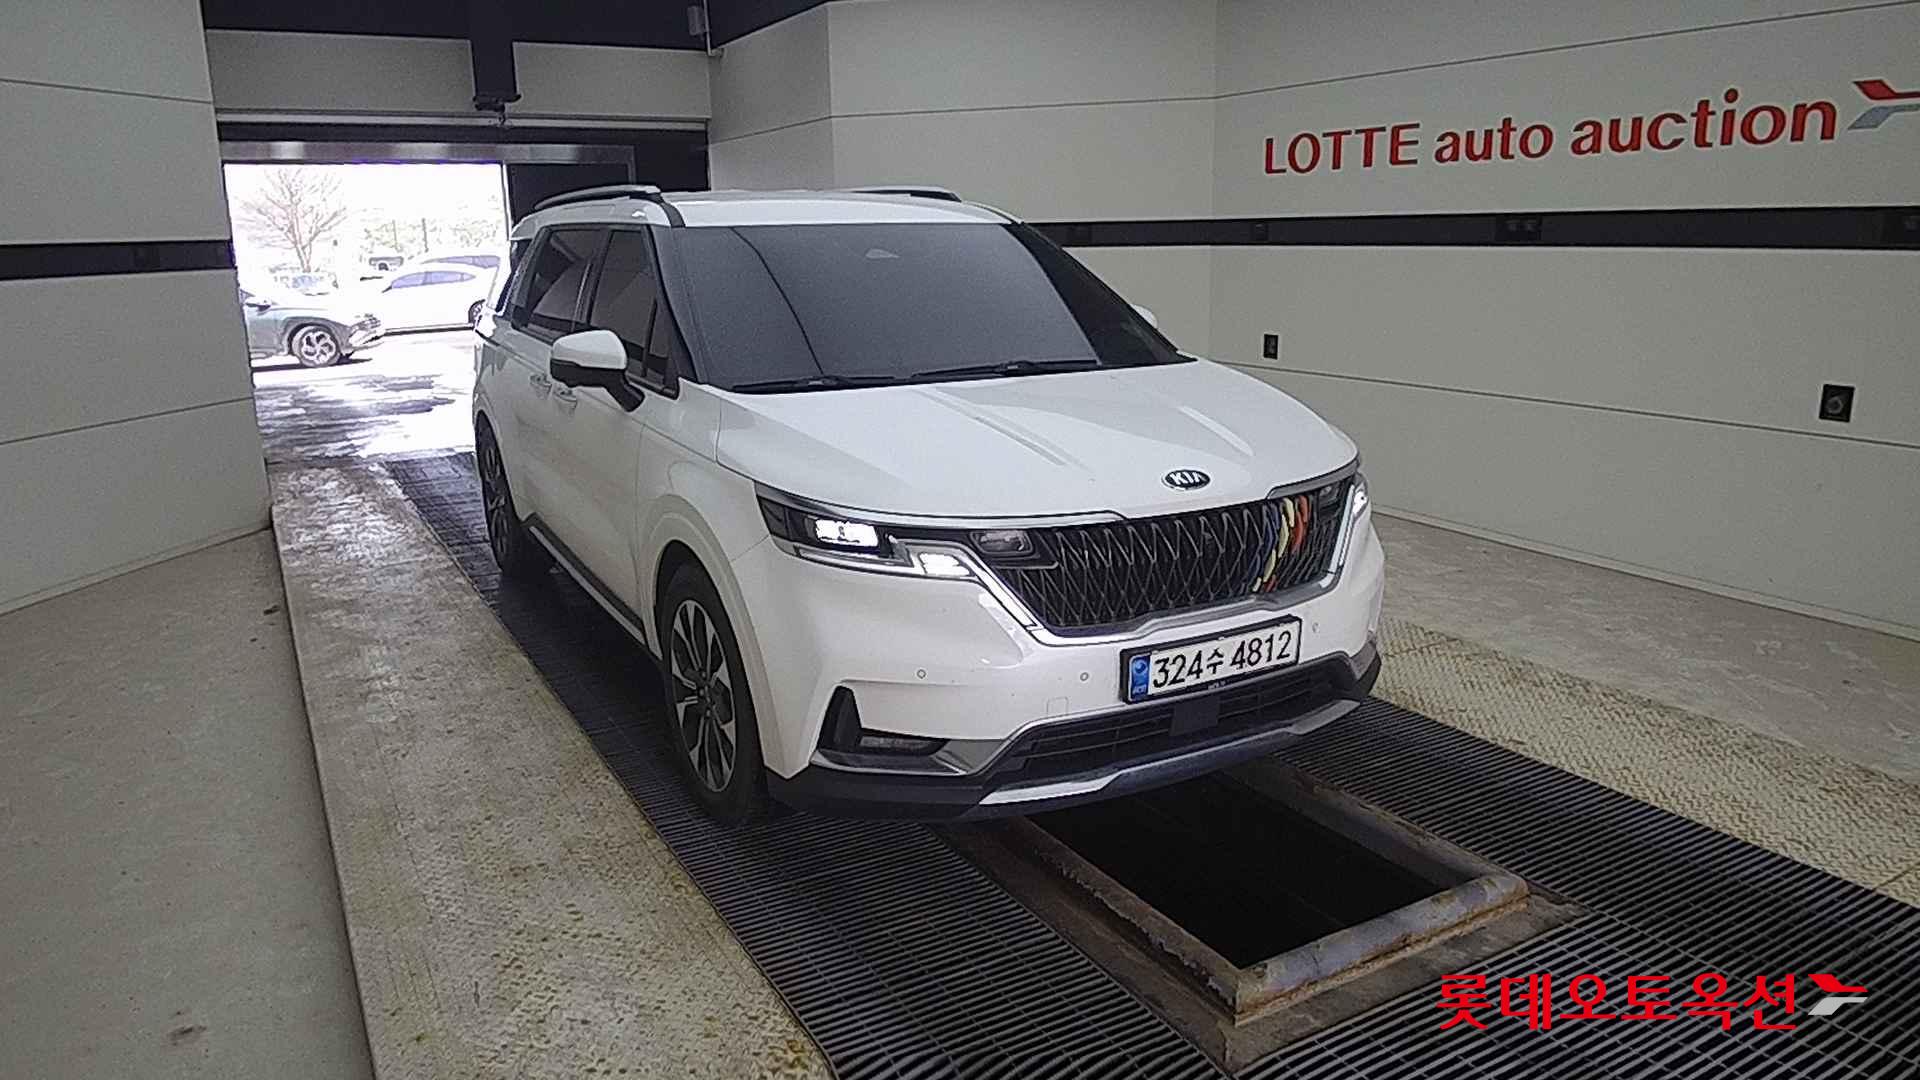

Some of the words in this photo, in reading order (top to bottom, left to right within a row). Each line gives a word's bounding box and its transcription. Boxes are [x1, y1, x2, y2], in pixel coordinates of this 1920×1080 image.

[1264, 123, 1421, 174] LOTTE
[1434, 117, 1553, 163] auto
[1570, 88, 1838, 155] auction
[1169, 471, 1207, 485] KIA
[1153, 649, 1224, 688] 324수
[1230, 631, 1292, 669] 4812
